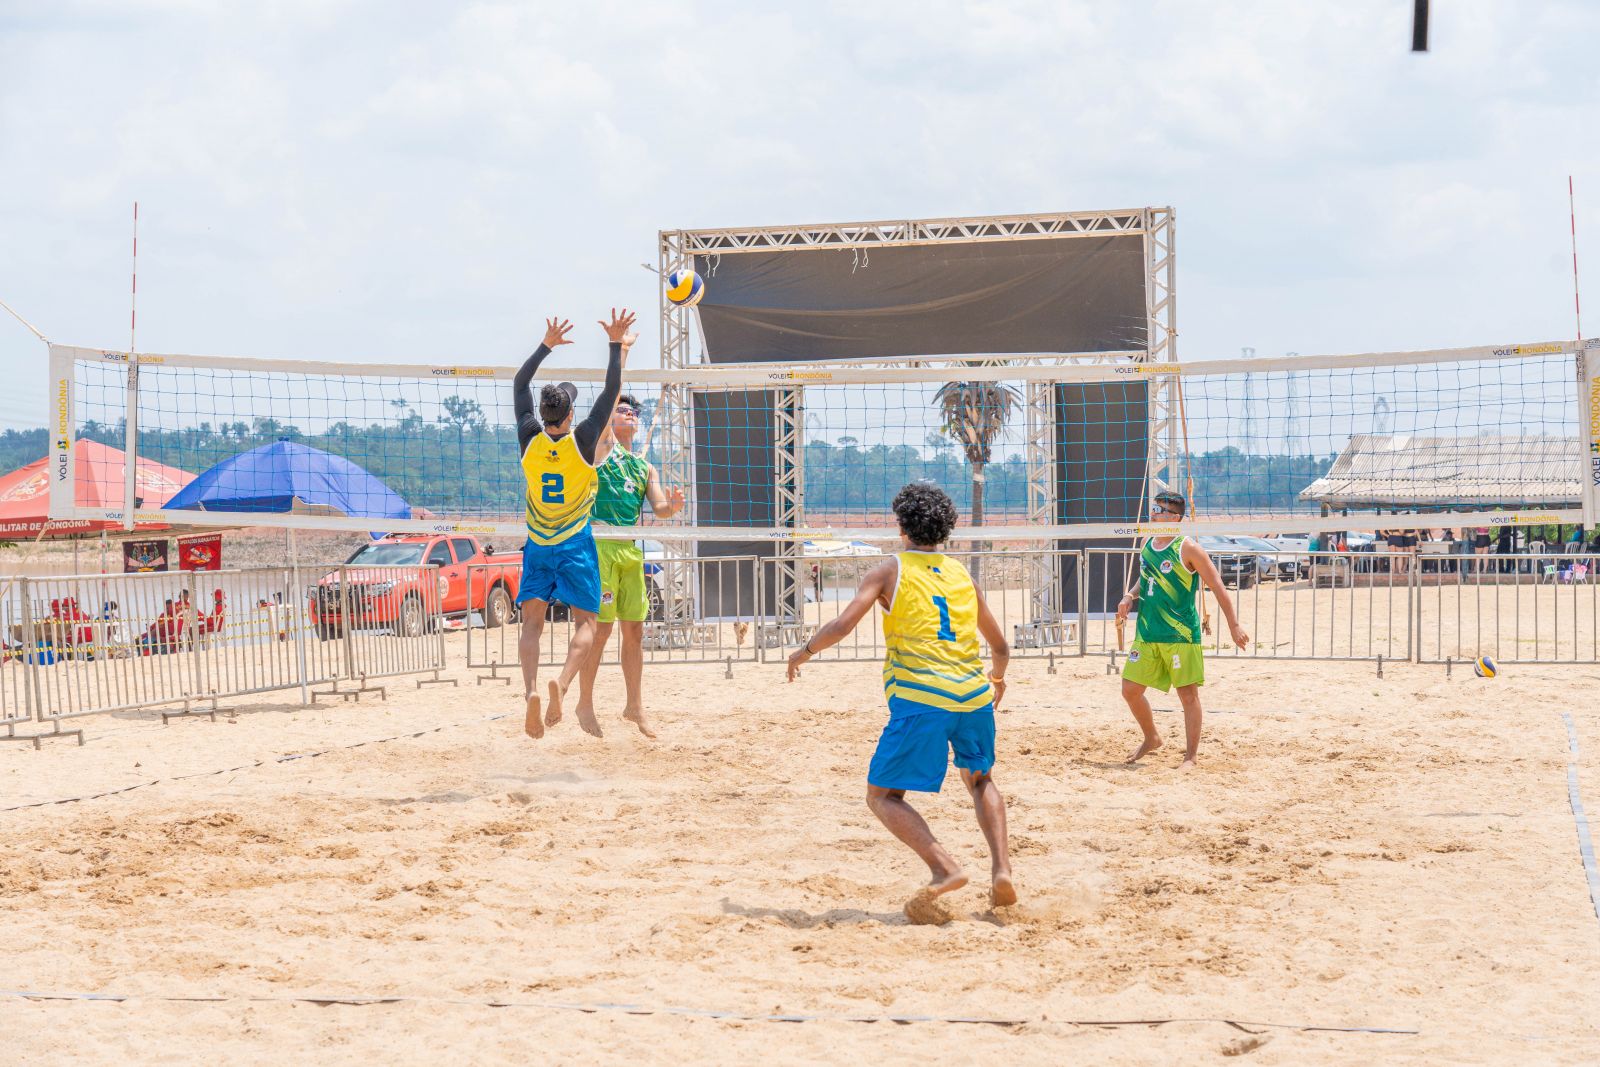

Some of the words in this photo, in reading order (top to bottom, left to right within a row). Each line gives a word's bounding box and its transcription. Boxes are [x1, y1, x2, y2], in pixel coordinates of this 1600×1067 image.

[58, 378, 67, 434] RONDÔNIA
[541, 472, 565, 504] 2
[29, 522, 42, 531] DE
[1147, 576, 1155, 596] 1
[932, 595, 957, 642] 1
